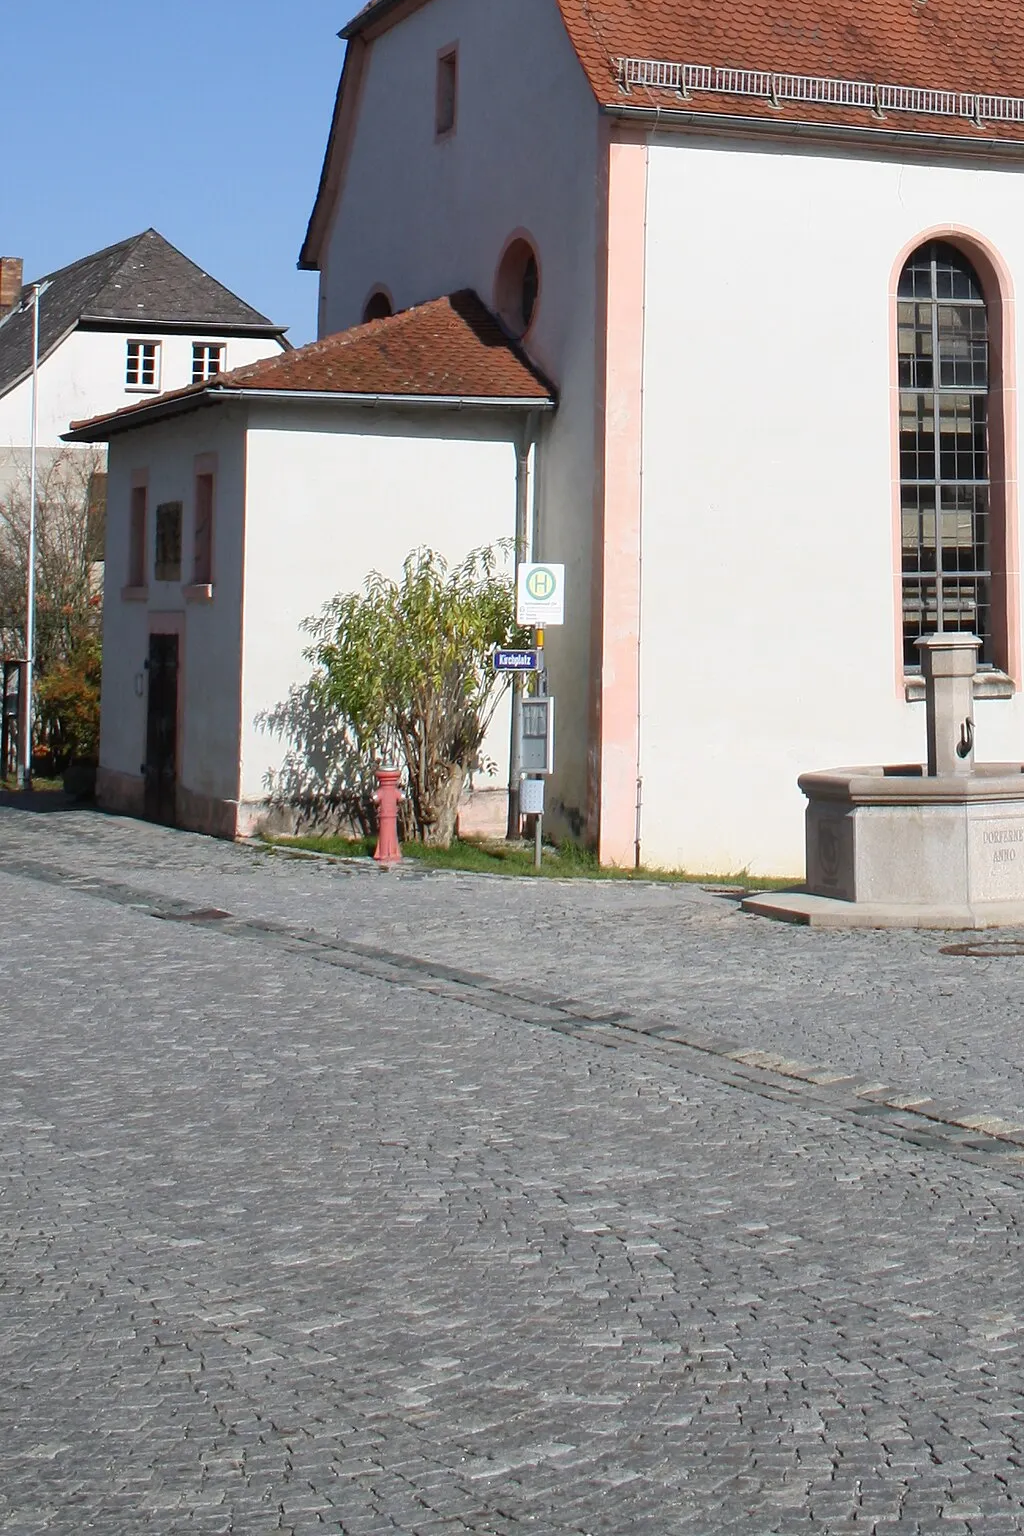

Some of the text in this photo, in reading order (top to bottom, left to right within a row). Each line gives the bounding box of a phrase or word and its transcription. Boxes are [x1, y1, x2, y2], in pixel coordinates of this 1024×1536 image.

[534, 574, 548, 593] H
[499, 653, 532, 667] Kirchplatz
[993, 848, 1016, 863] ANNO
